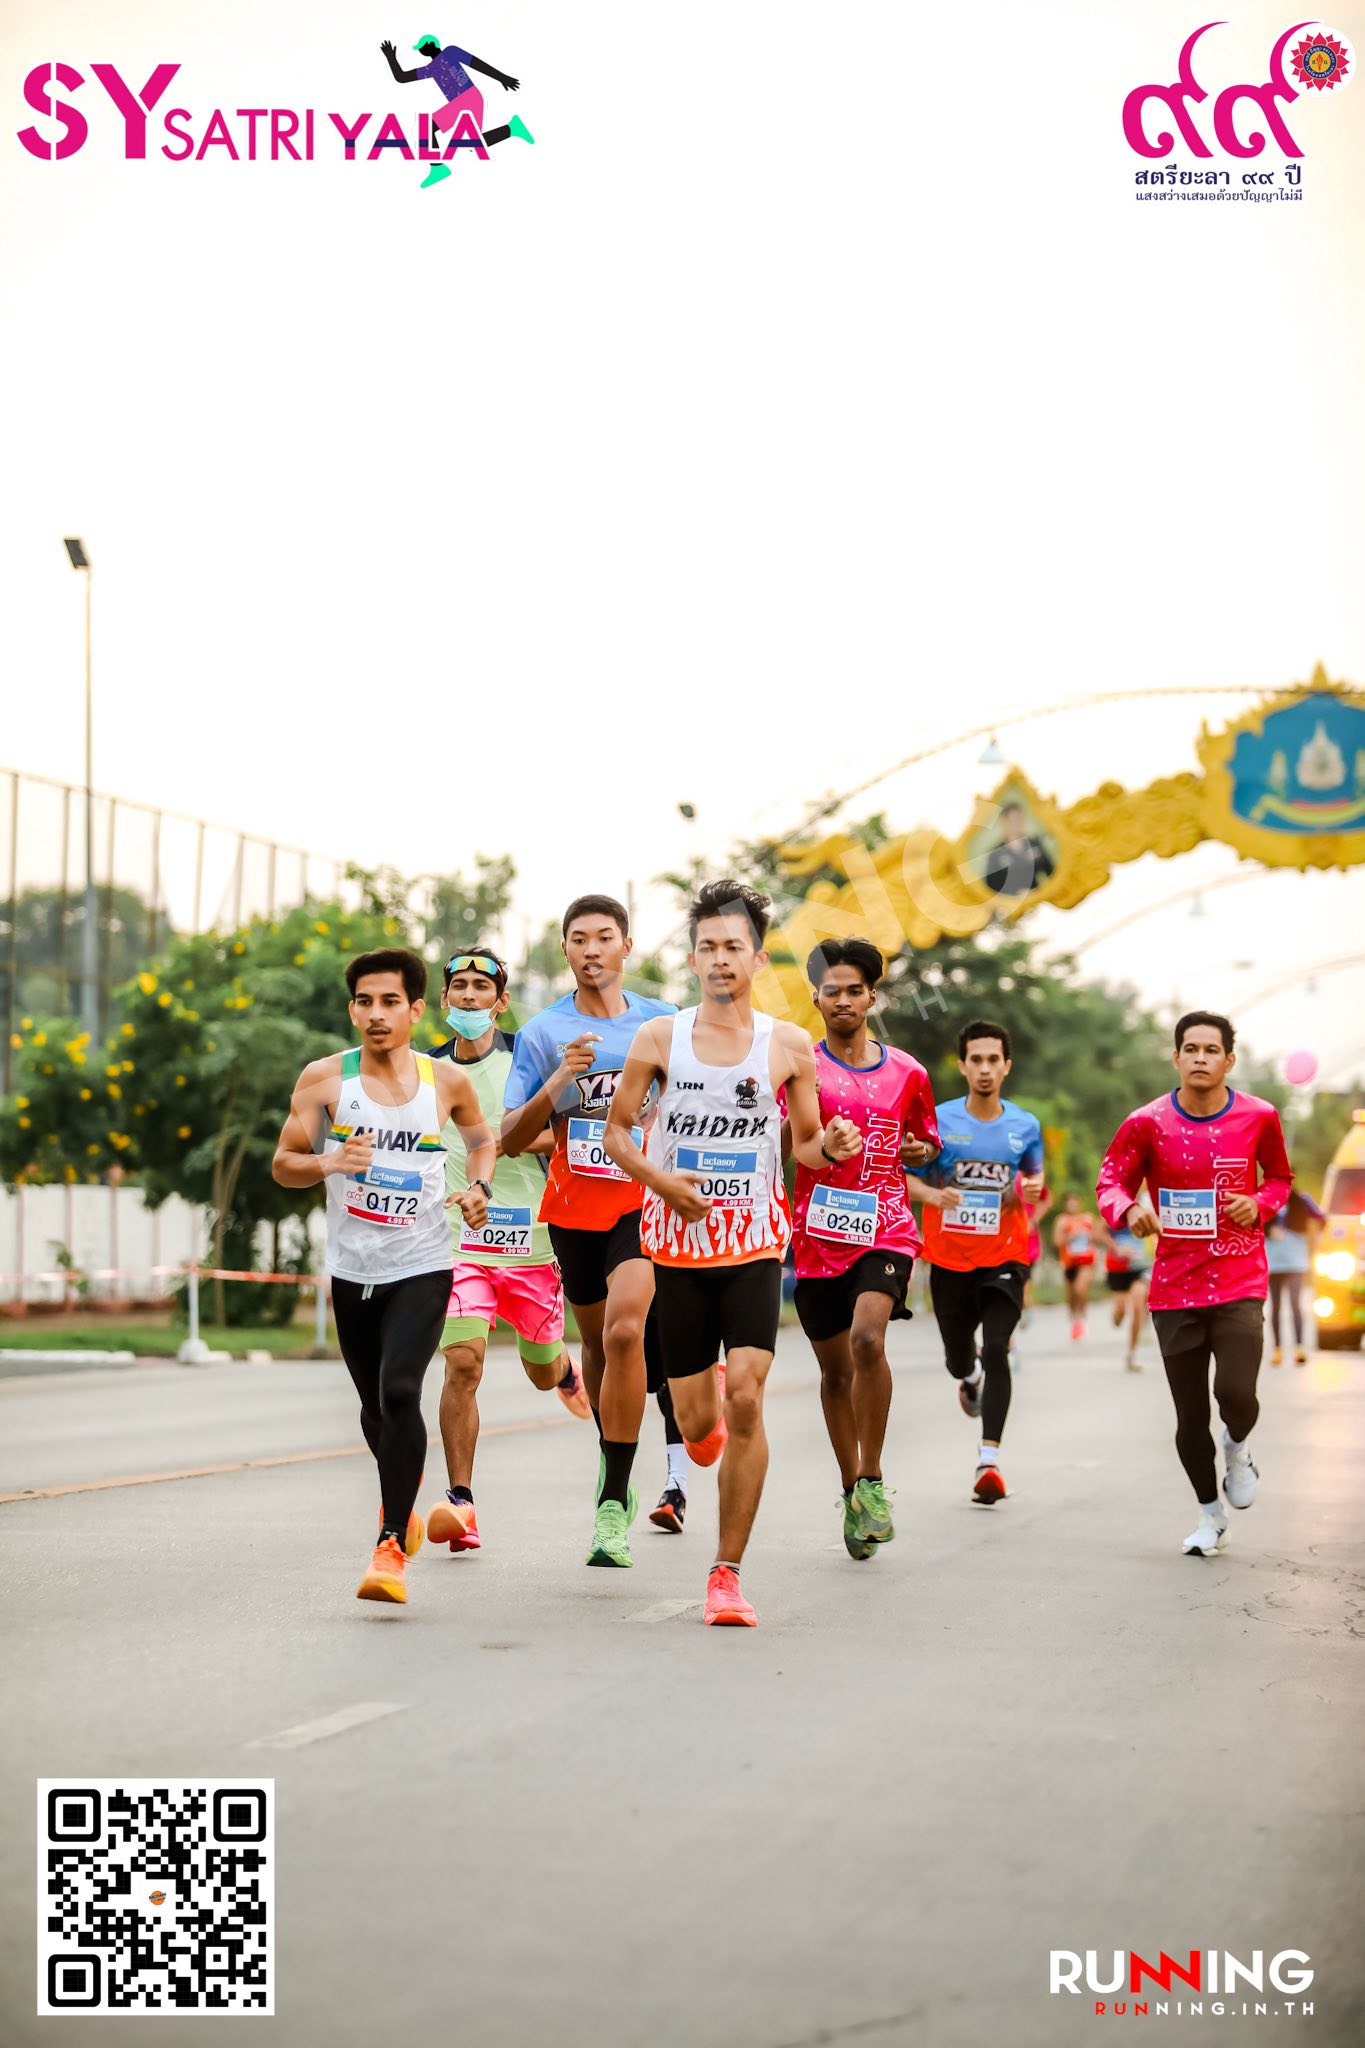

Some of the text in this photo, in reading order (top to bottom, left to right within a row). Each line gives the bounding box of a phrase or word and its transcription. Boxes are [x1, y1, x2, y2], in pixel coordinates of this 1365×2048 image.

[676, 1081, 704, 1091] LRN
[590, 1147, 613, 1166] 00
[697, 1152, 737, 1170] Lactasoy
[364, 1166, 404, 1186] Lactasoy
[956, 1161, 1010, 1183] YKN
[700, 1178, 750, 1196] 0051
[366, 1192, 418, 1215] 0172
[722, 1199, 738, 1207] 4.99
[826, 1190, 860, 1207] Lactasoy
[386, 1216, 403, 1225] 4.99
[827, 1213, 873, 1234] 0246
[960, 1210, 997, 1225] 0142
[1177, 1213, 1211, 1226] 0321
[483, 1229, 529, 1246] 0247
